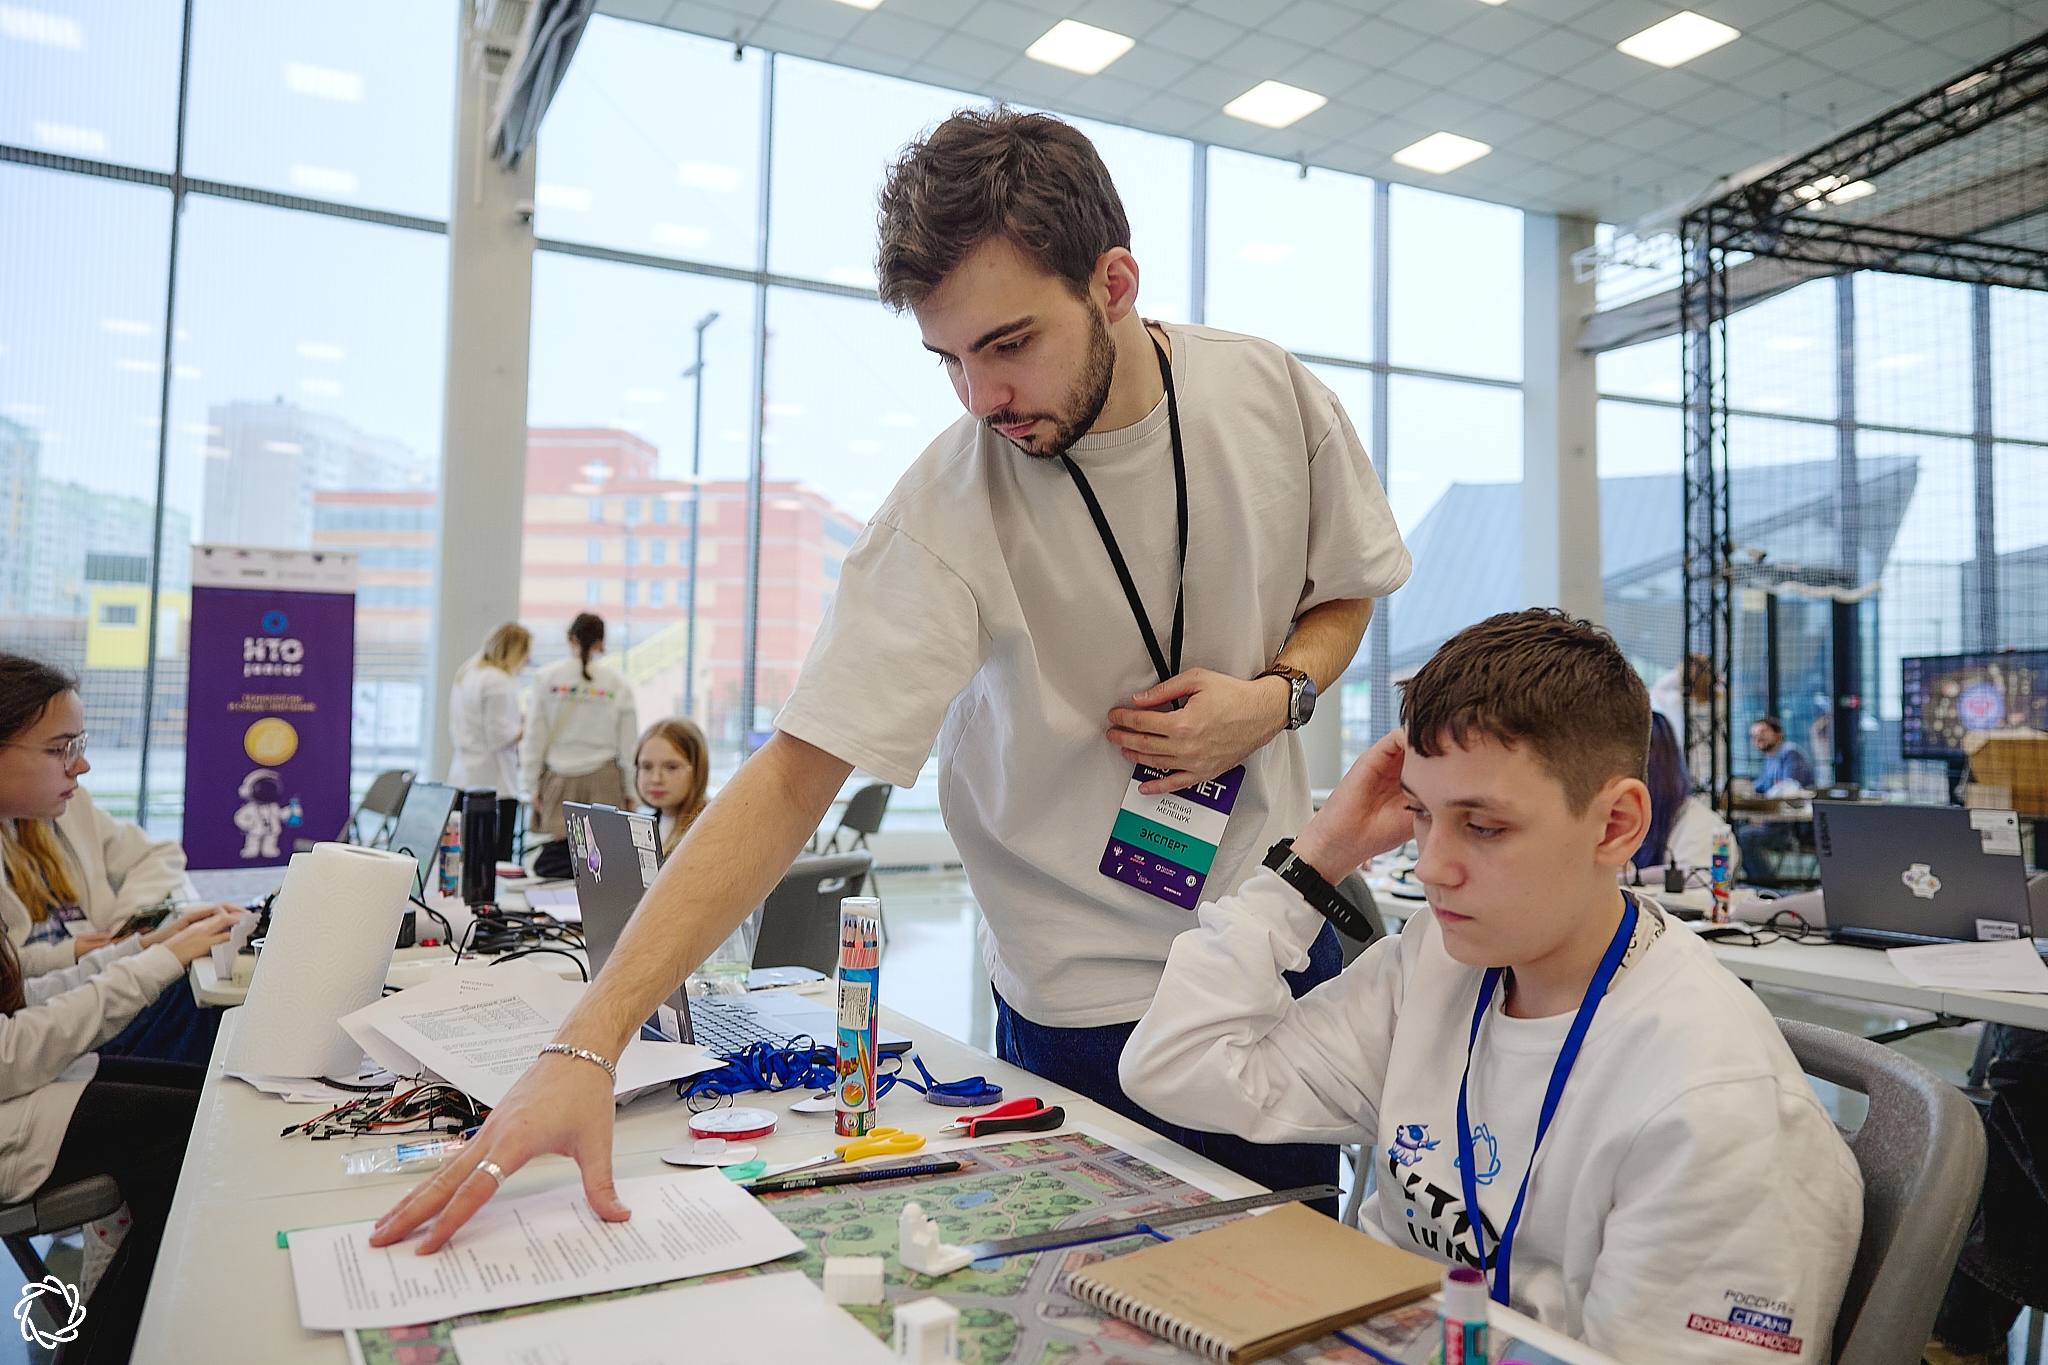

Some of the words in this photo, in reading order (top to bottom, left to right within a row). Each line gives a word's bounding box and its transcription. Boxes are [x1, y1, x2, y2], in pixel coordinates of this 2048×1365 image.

[244, 638, 304, 663] НТО
[1144, 767, 1167, 779] junio
[1156, 805, 1190, 824] МЕЛЕЩУК
[1160, 798, 1192, 816] АРСЕНИЙ
[1139, 828, 1188, 854] ЭКСПЕРТ
[1724, 1289, 1787, 1311] РОССИЯ
